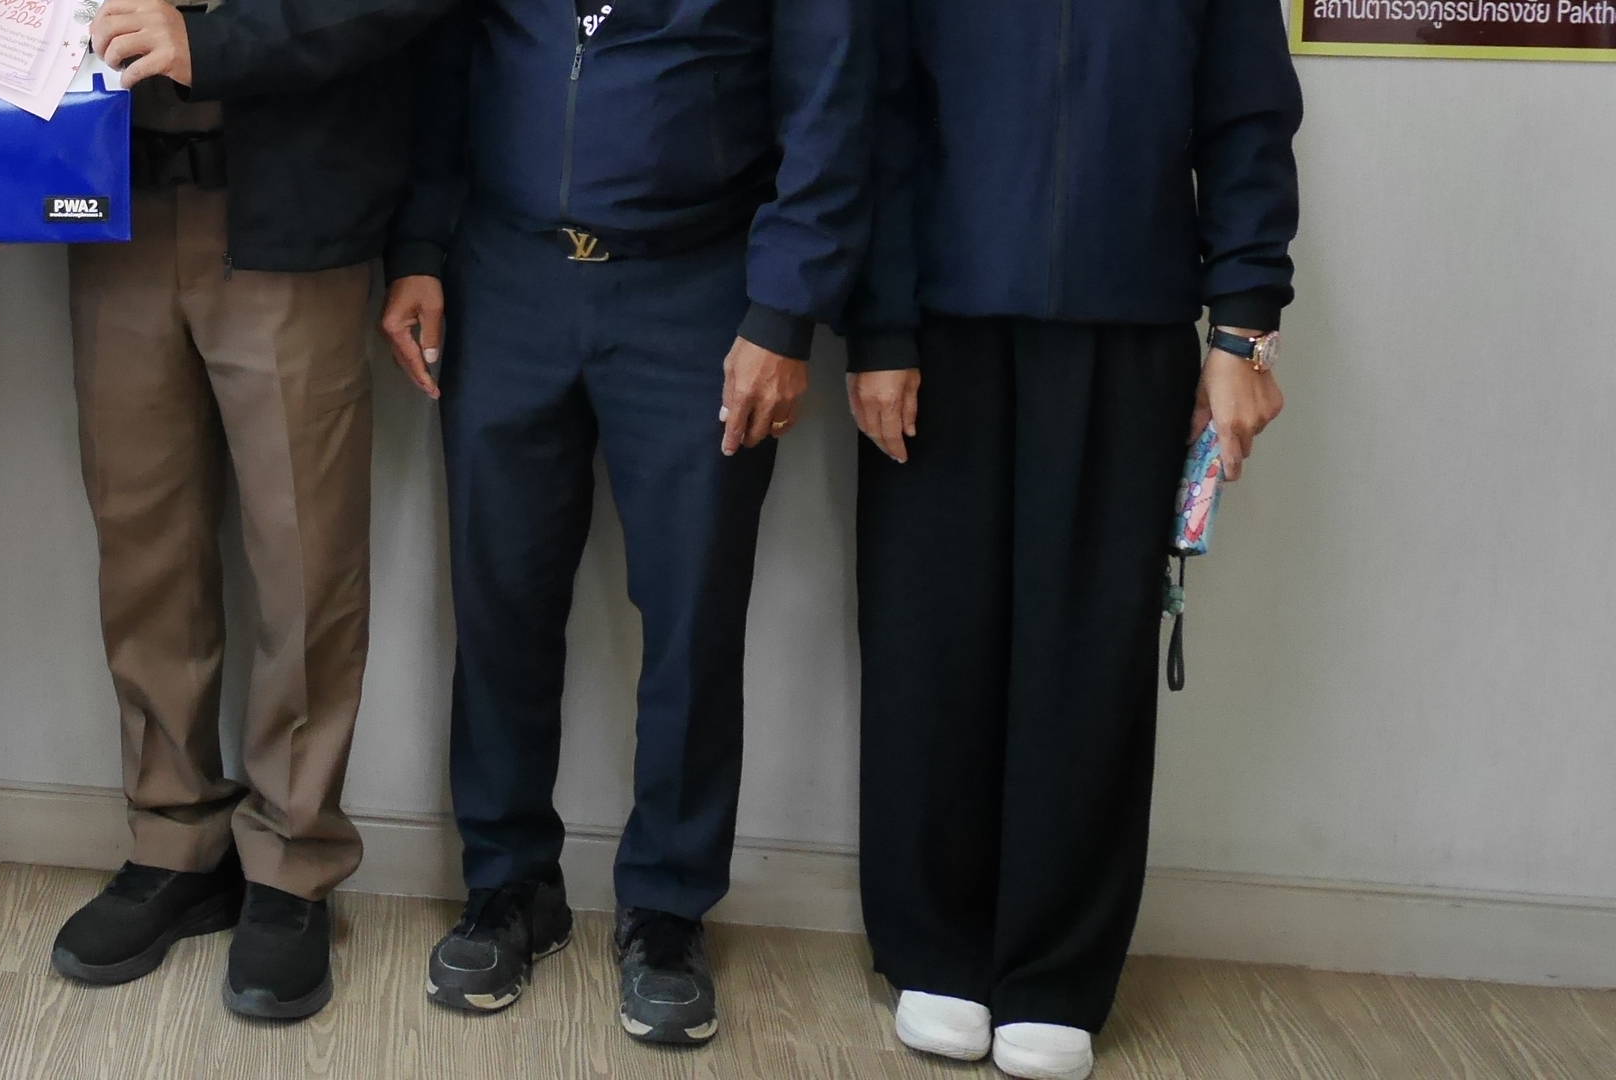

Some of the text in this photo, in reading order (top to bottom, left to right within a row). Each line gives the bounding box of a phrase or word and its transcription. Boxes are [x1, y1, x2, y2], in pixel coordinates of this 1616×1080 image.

[6, 10, 43, 29] 2026
[1557, 0, 1616, 25] Pakth
[54, 199, 99, 213] PWA2
